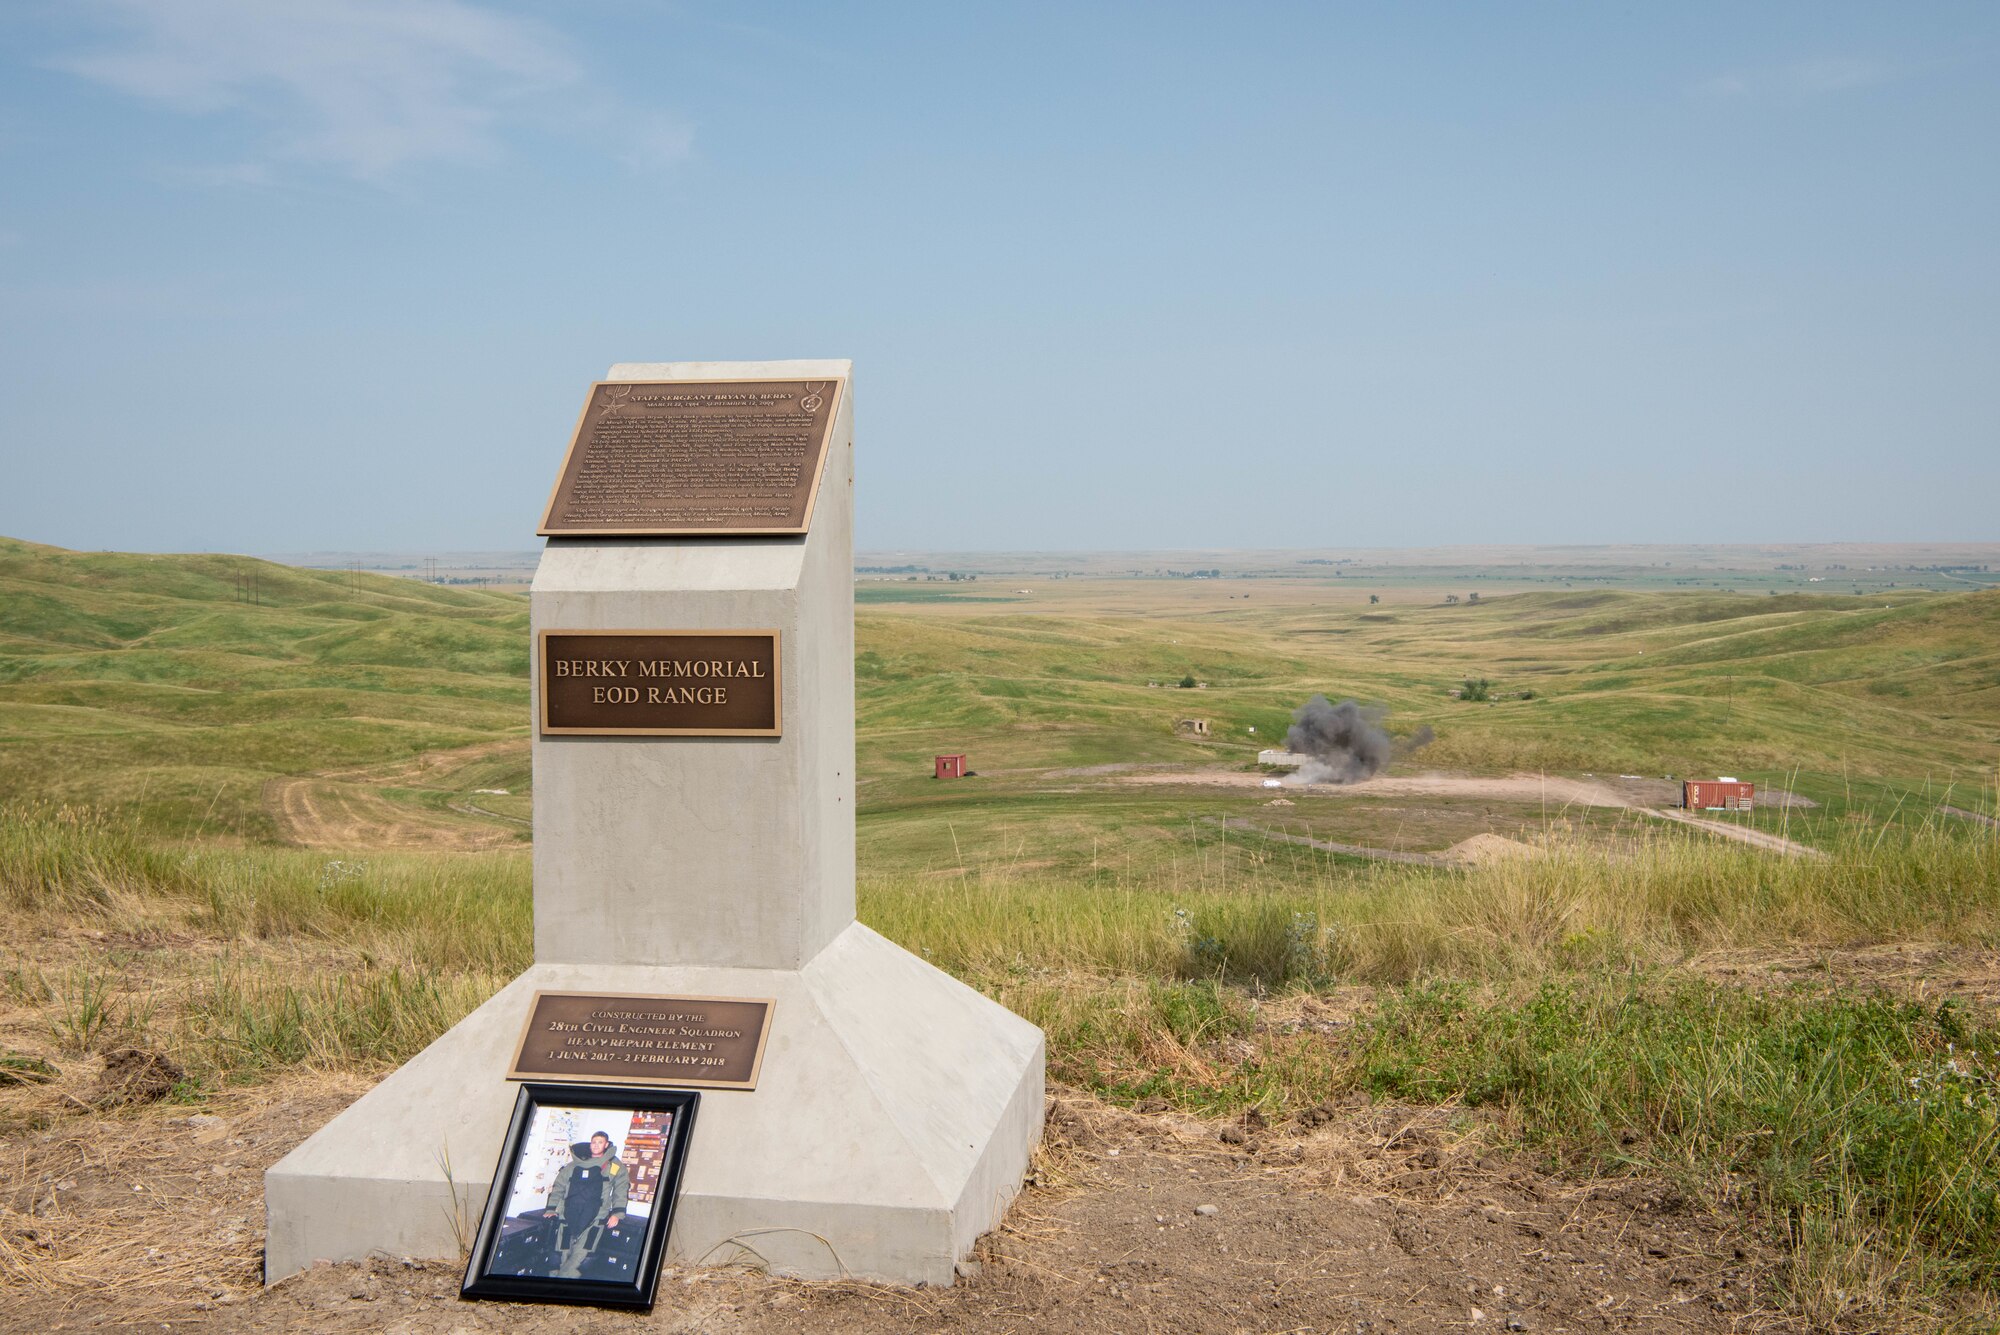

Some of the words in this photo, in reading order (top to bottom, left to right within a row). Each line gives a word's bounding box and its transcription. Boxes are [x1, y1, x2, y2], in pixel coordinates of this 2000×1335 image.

[555, 660, 631, 677] BERKY
[637, 660, 766, 678] MEMORIAL
[592, 686, 640, 704] EOD
[647, 686, 728, 705] RANGE
[591, 1011, 666, 1021] CONSTRUCTED
[668, 1013, 684, 1021] BY
[685, 1014, 705, 1022] THE
[567, 1037, 608, 1047] HEAVY
[609, 1038, 654, 1049] REPAIR
[656, 1040, 715, 1051] ELEMENT
[548, 1050, 554, 1059] 1
[557, 1050, 588, 1060] JUNE
[590, 1052, 616, 1061] 2017
[624, 1053, 631, 1062] 2
[633, 1054, 699, 1065] FEBRUARY
[700, 1057, 726, 1067] 2018
